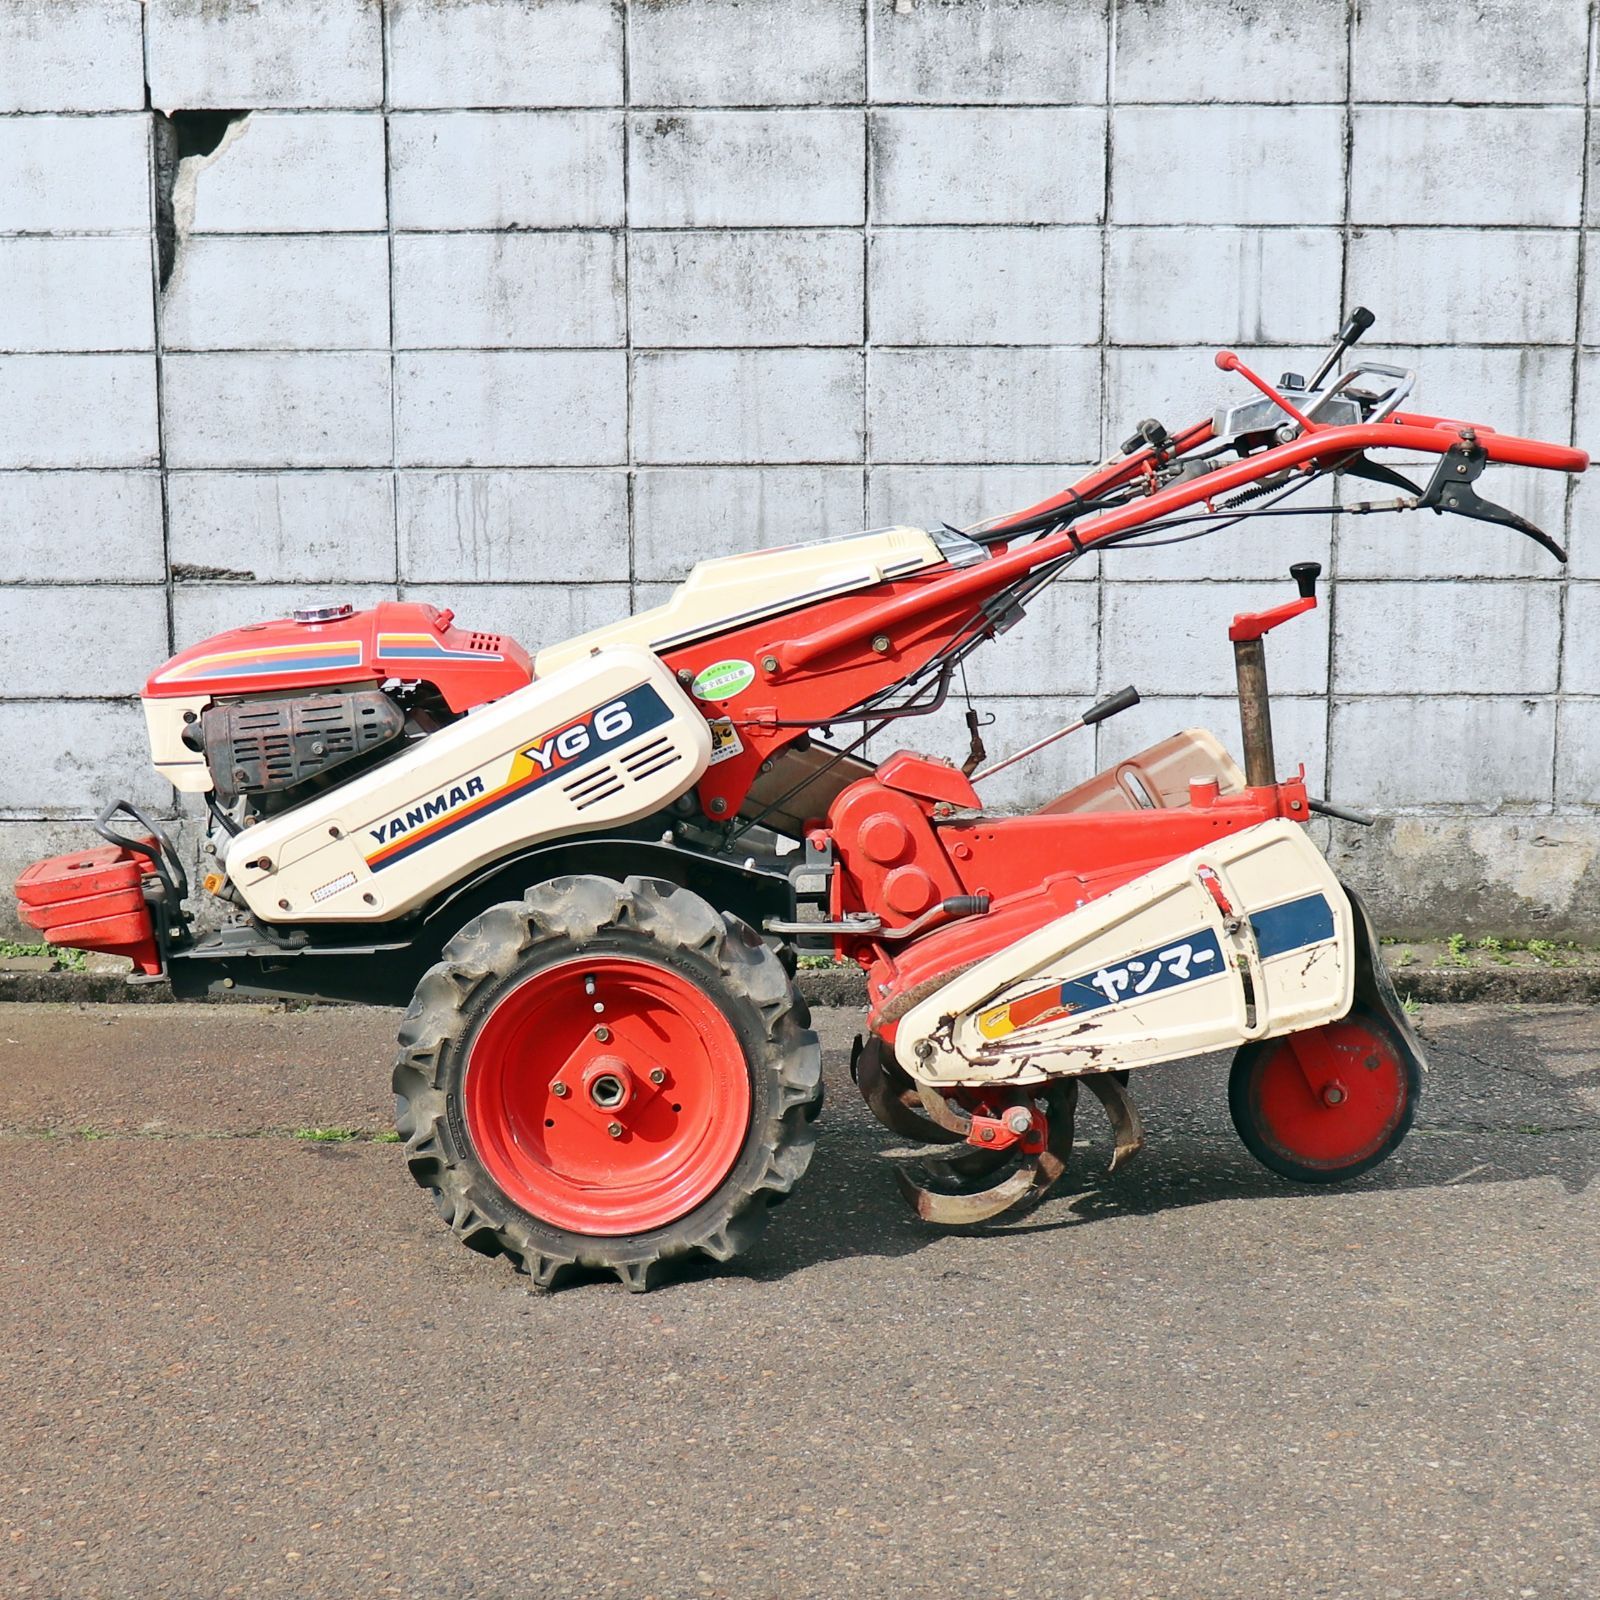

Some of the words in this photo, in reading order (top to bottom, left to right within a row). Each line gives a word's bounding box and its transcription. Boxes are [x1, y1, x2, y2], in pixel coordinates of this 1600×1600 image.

[521, 700, 633, 771] YG6
[369, 776, 485, 844] YANMAR
[1092, 944, 1215, 1003] ヤンマー
